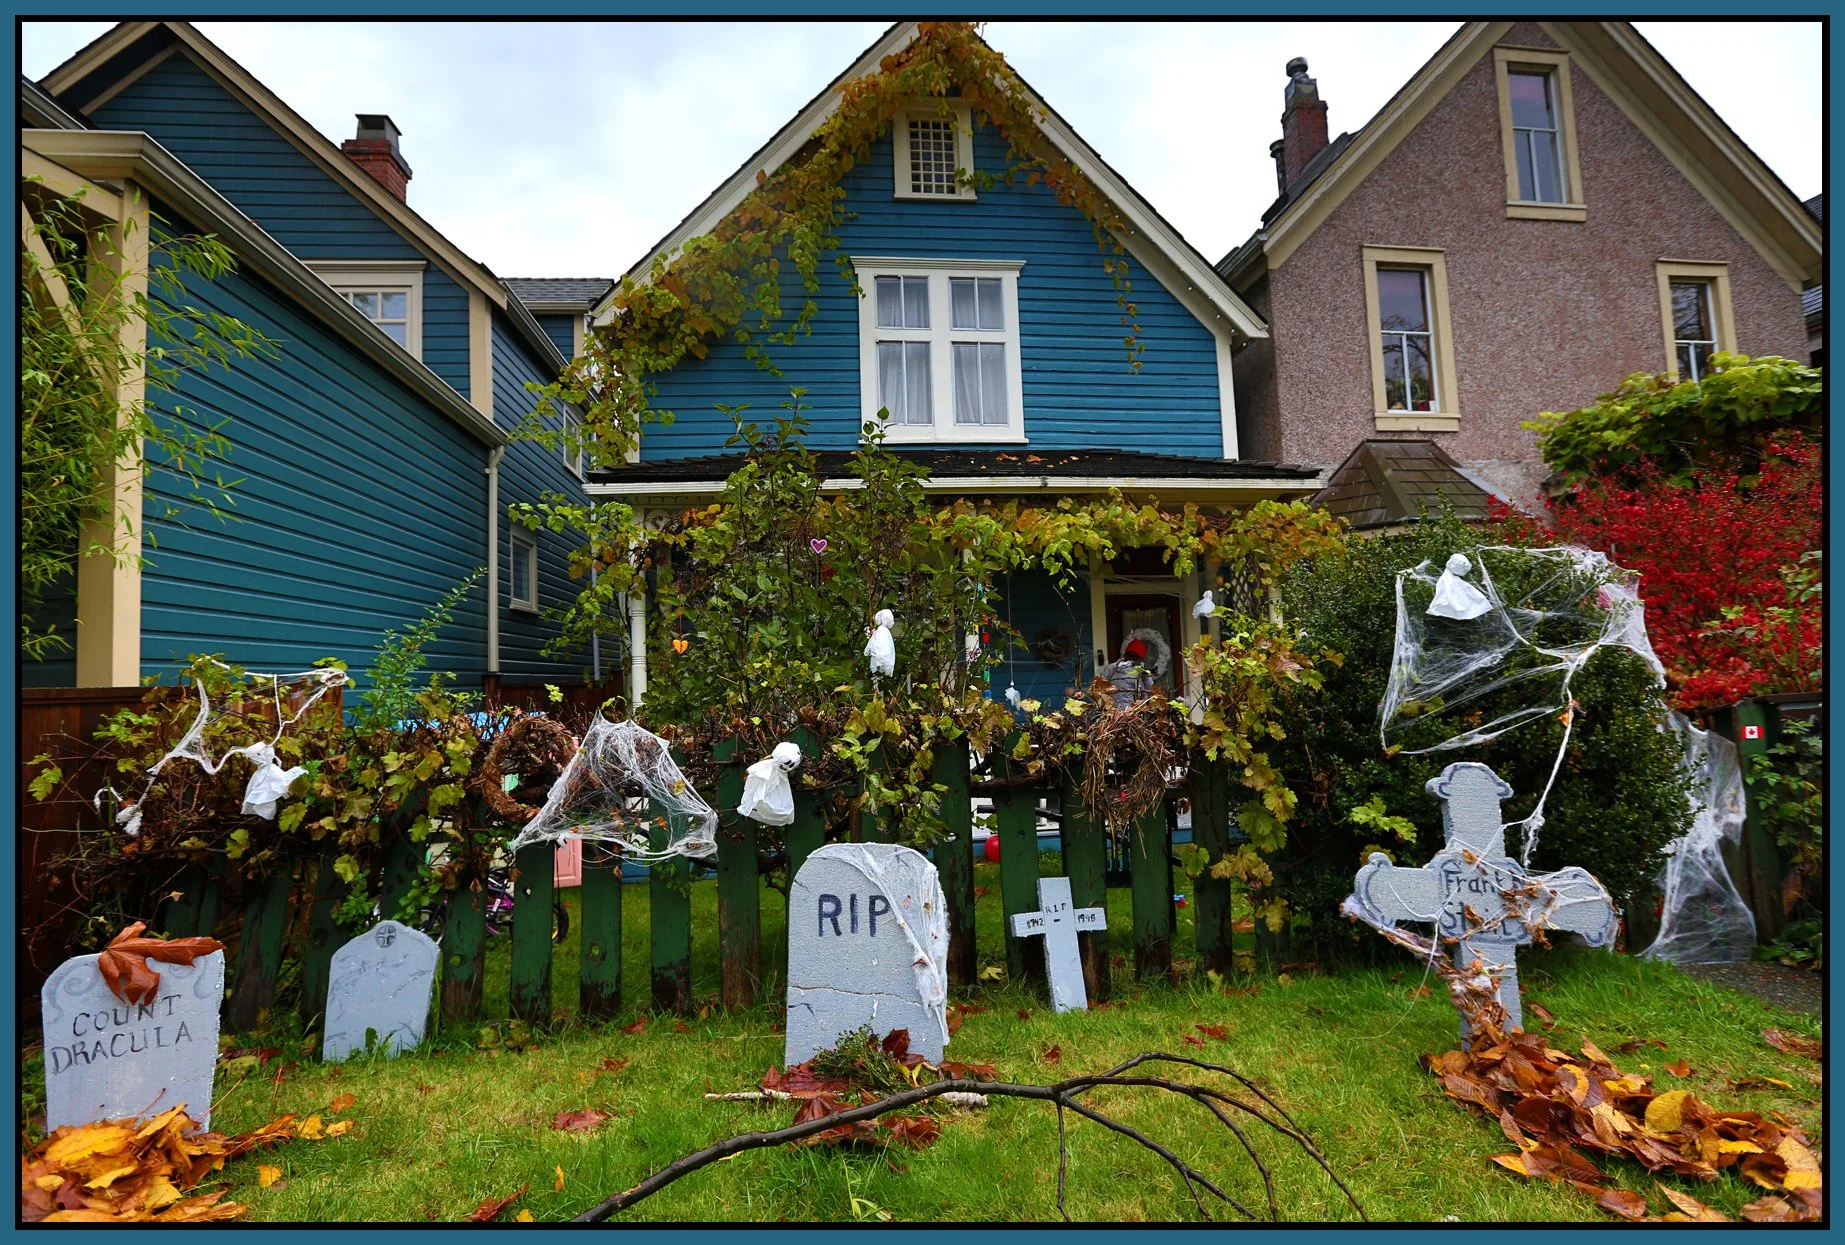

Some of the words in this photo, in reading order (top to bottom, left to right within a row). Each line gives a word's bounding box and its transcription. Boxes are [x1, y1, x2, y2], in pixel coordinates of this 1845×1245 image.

[818, 893, 889, 937] RIP
[1045, 902, 1067, 914] RIP
[72, 994, 182, 1037] COUNT
[51, 1021, 193, 1076] DRACULA
